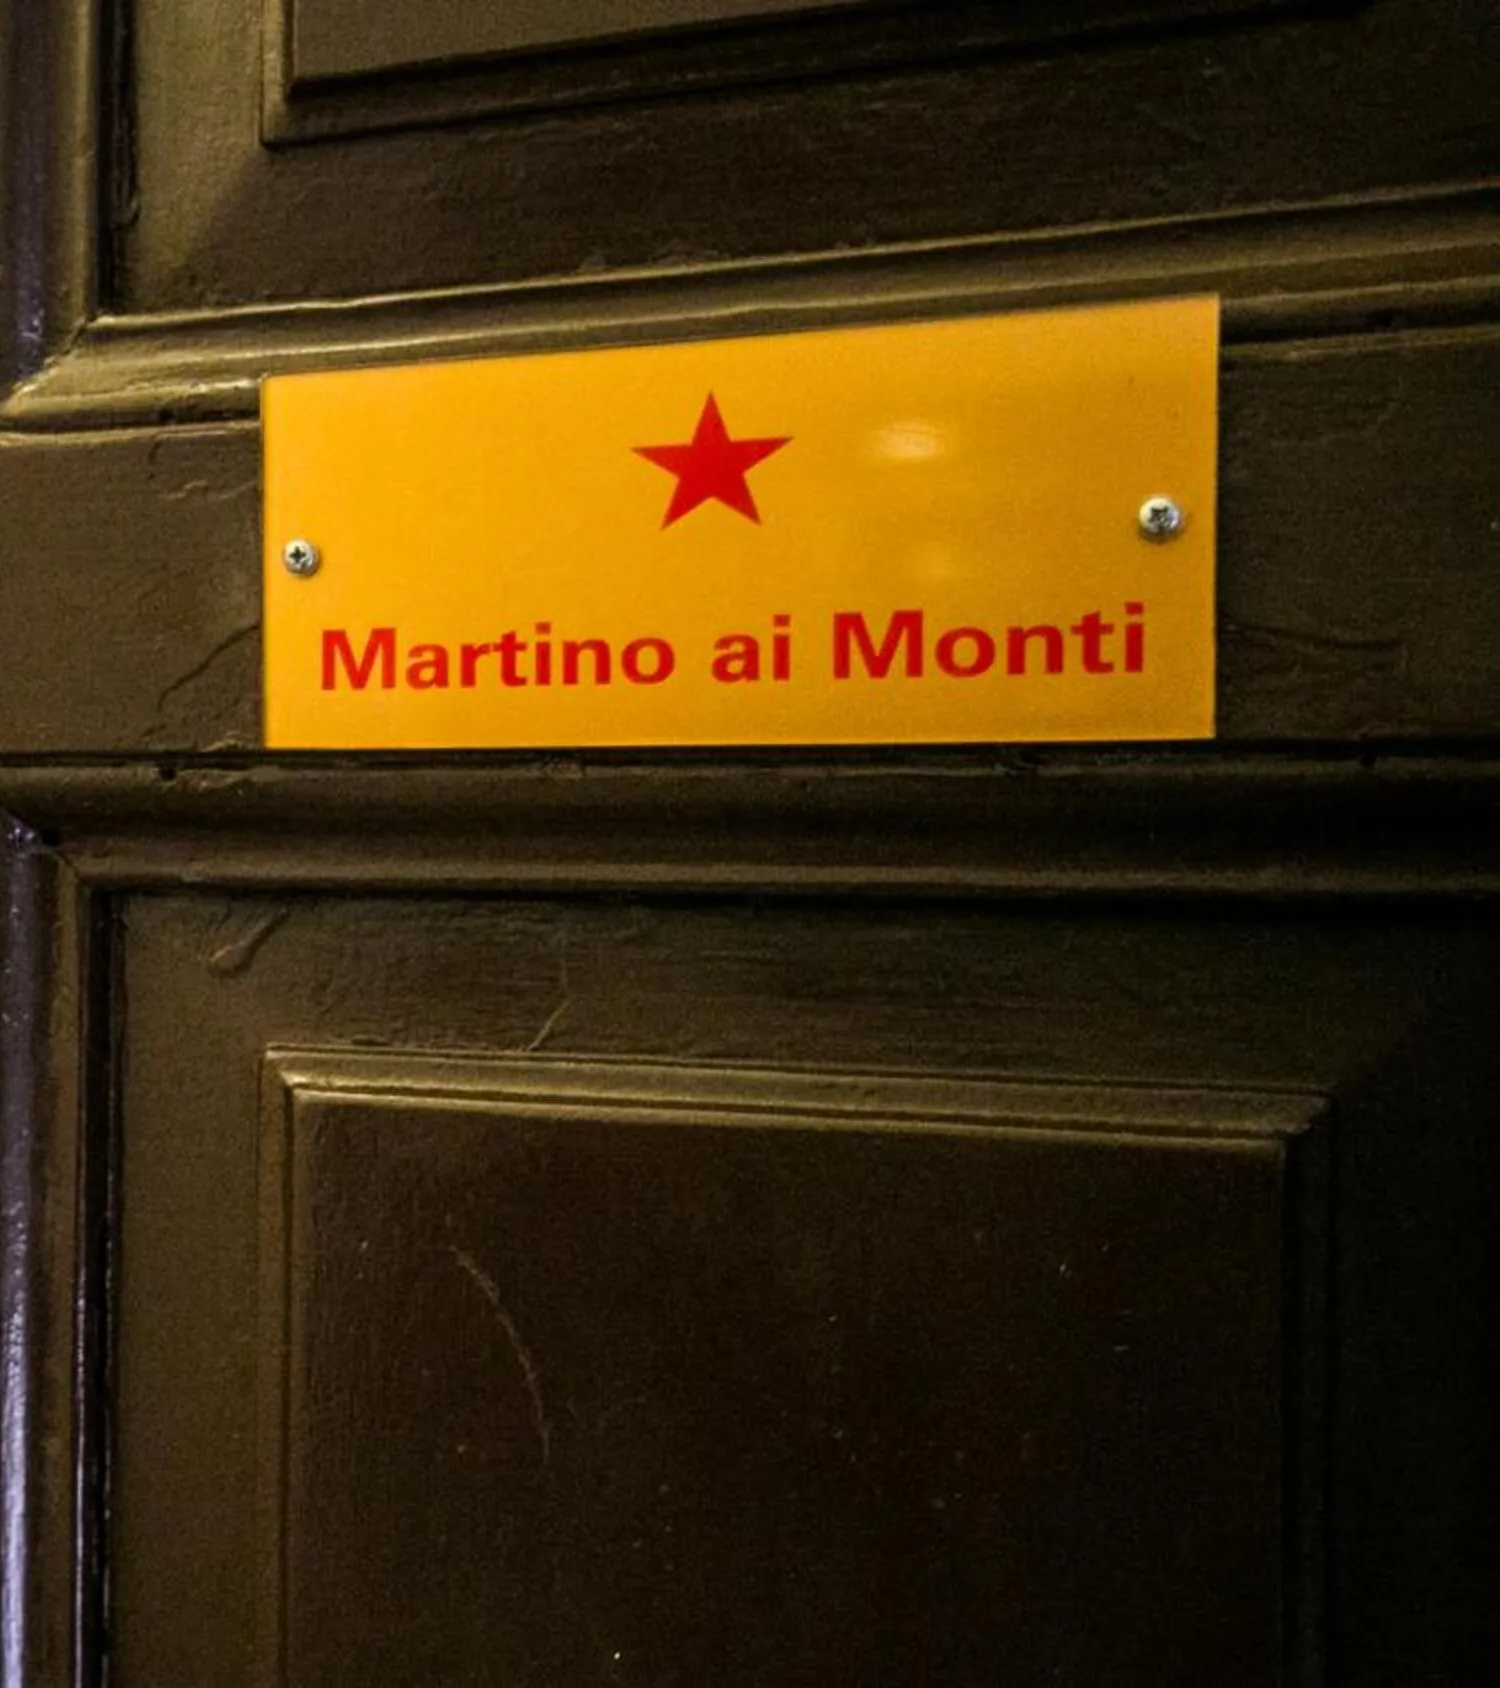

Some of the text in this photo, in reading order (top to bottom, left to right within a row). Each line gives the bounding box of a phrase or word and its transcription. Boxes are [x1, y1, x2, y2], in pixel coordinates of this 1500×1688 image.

[321, 600, 1147, 691] Martino ai Monti
